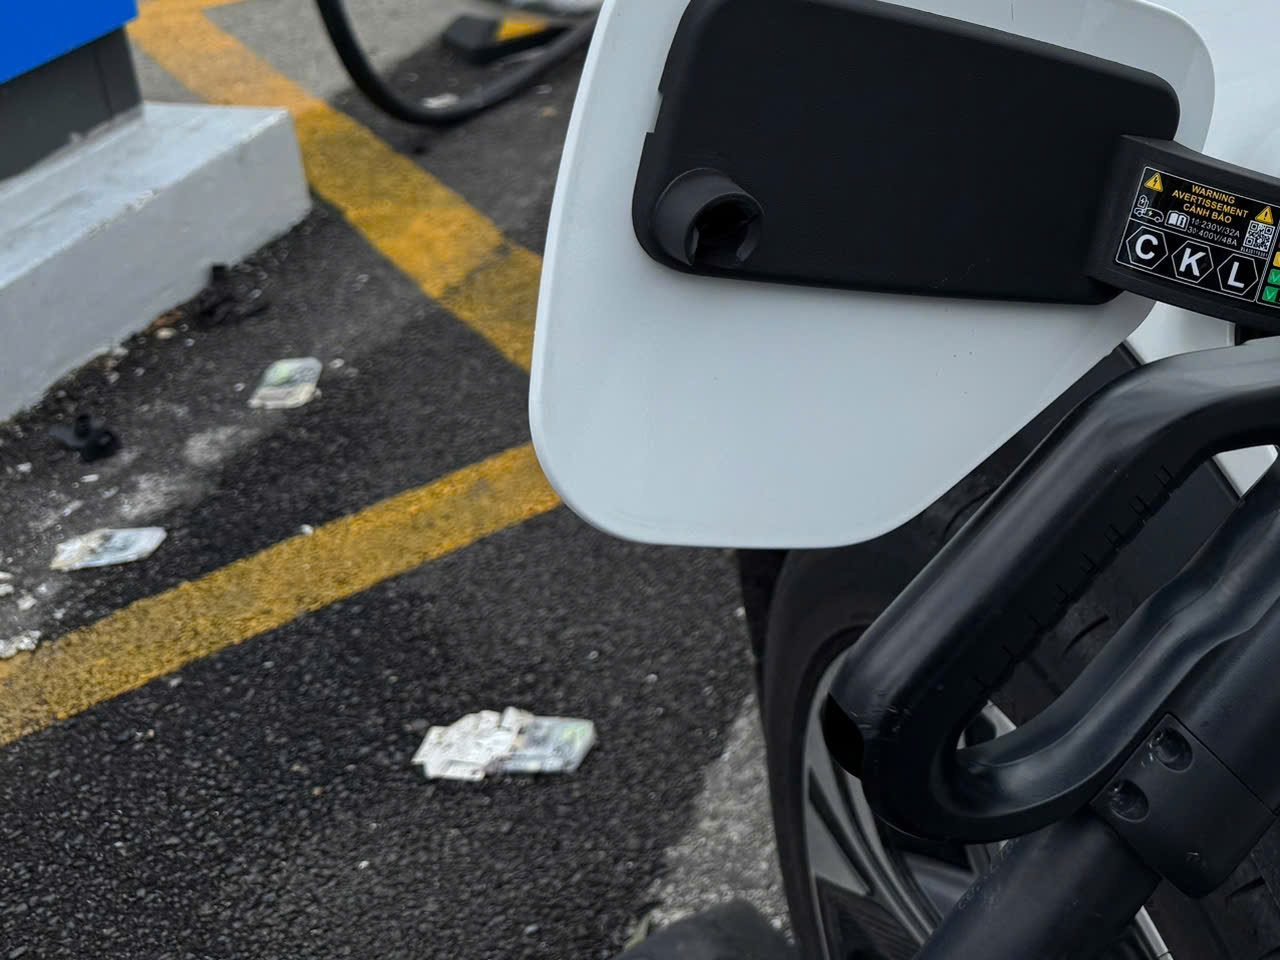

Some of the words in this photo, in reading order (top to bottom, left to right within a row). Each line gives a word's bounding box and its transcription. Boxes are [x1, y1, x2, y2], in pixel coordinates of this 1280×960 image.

[1171, 190, 1248, 218] AVERTISSEMENT
[1192, 184, 1235, 204] WARNING
[1135, 234, 1159, 260] C
[1179, 247, 1206, 276] K
[1227, 261, 1245, 289] L
